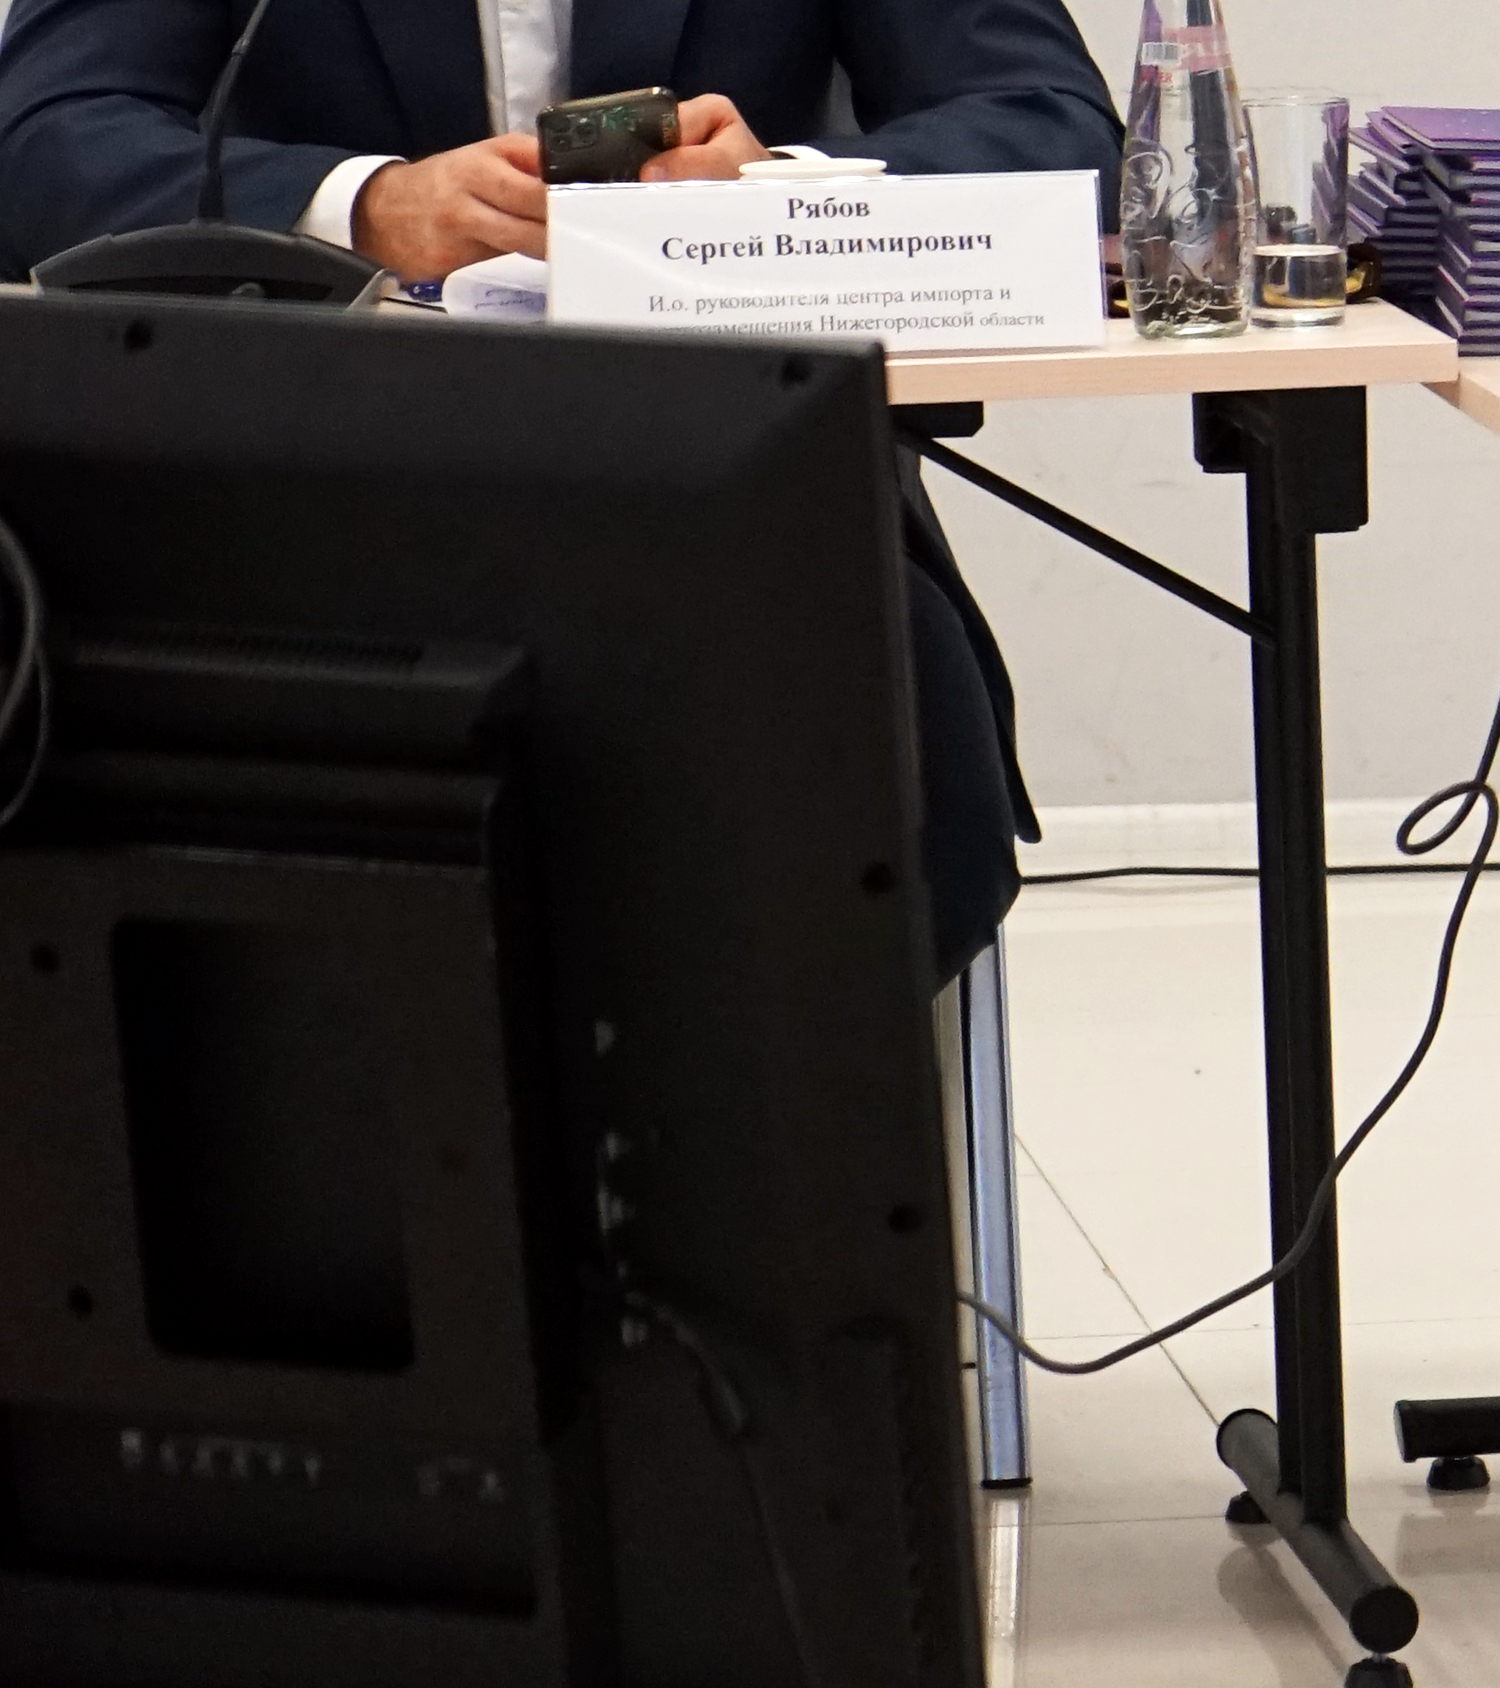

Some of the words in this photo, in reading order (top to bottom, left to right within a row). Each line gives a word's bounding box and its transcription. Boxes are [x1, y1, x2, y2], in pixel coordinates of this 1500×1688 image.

[786, 196, 871, 220] Рябов
[661, 235, 764, 265] Сергей
[775, 233, 993, 259] Владимирович
[649, 295, 688, 312] И.о.
[695, 291, 830, 314] руководителя
[836, 290, 905, 308] центра
[910, 288, 993, 306] импорта
[1000, 287, 1011, 300] и
[820, 312, 974, 333] Нижегородской
[979, 313, 1045, 328] области
